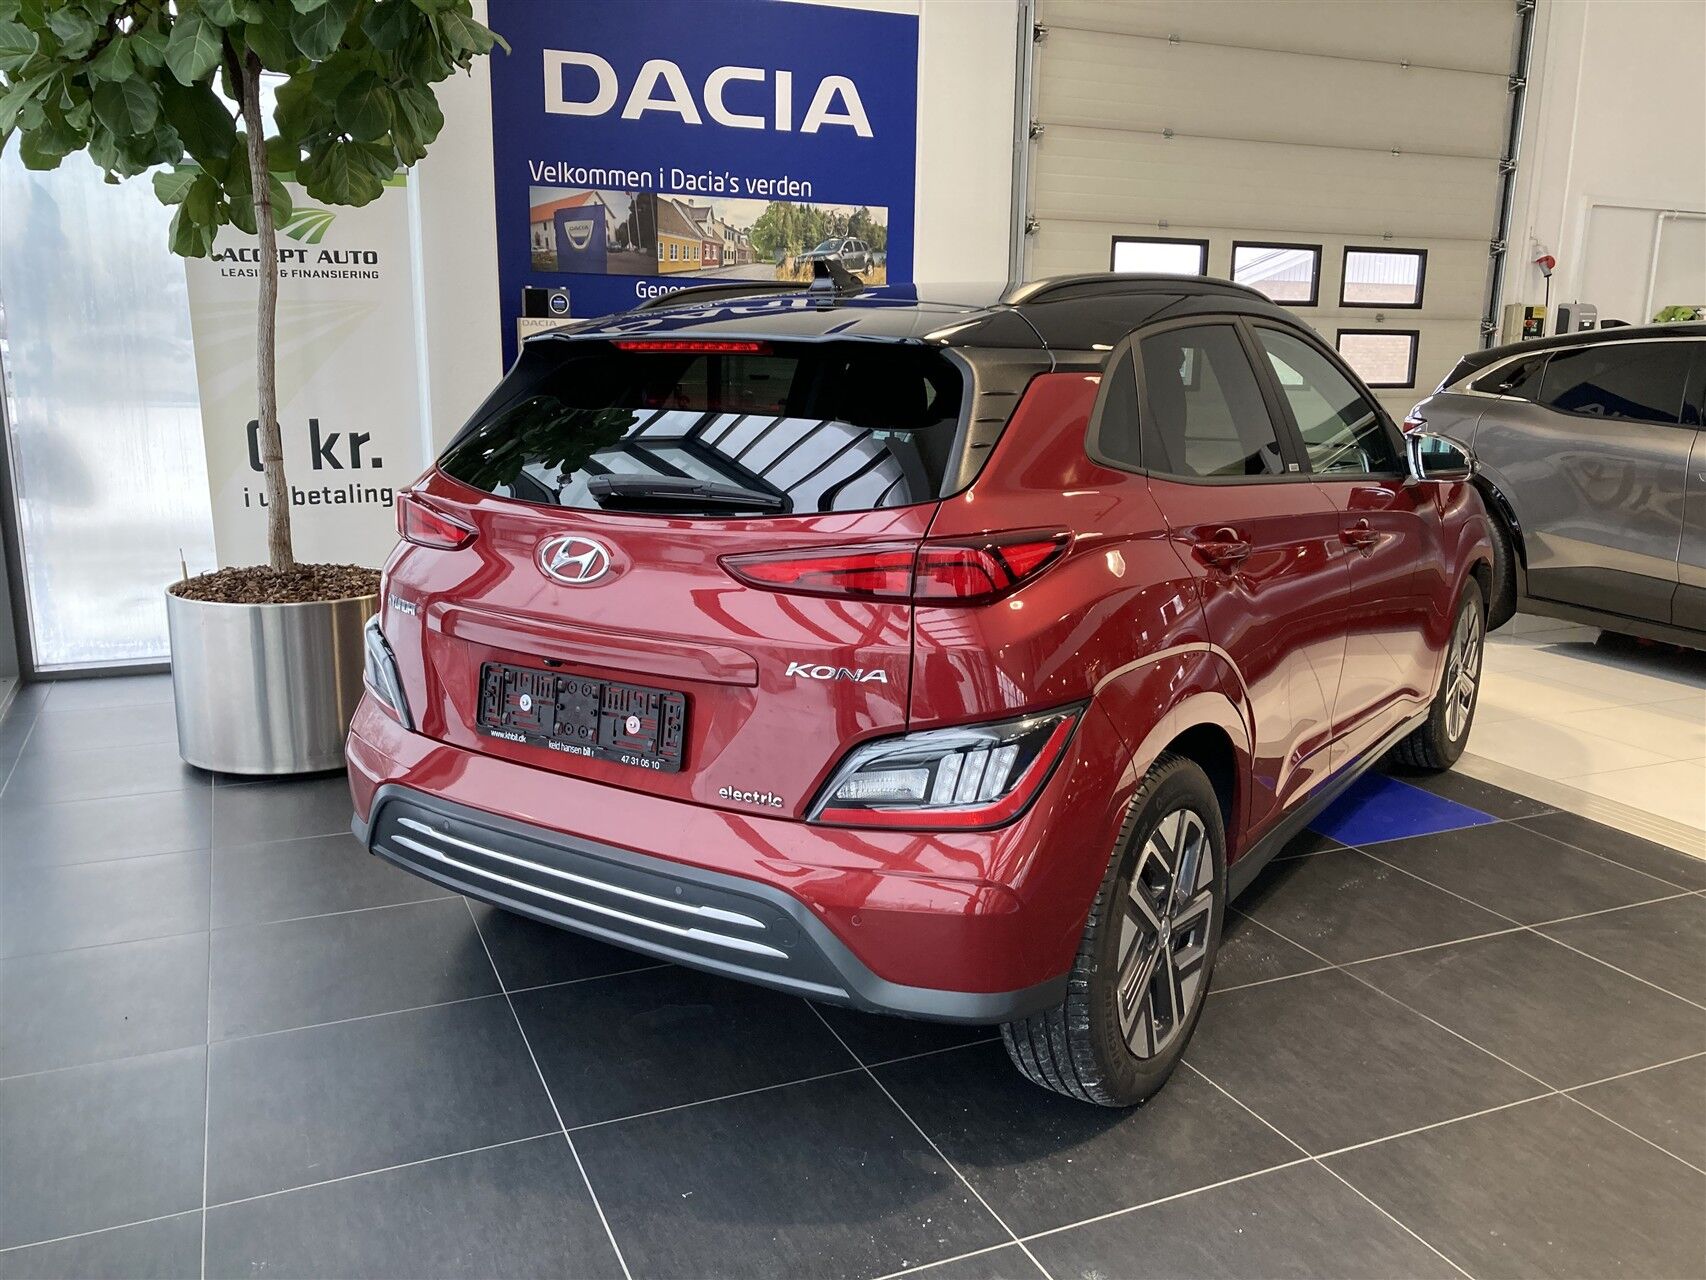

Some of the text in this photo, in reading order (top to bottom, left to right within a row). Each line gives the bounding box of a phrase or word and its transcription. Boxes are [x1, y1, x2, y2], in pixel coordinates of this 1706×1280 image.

[543, 49, 874, 138] DACIA
[529, 160, 812, 198] Velkommen i Dacia's verden
[222, 248, 379, 265] ACCPT AUTO
[221, 268, 379, 279] LEASI & FINANSIERING
[522, 319, 558, 327] DACIA
[309, 418, 383, 470] kr.
[244, 483, 394, 508] i ubetaling
[785, 662, 888, 684] KONA
[561, 743, 582, 755] hansen
[621, 755, 660, 770] 47 31 05 10
[719, 785, 784, 808] electric
